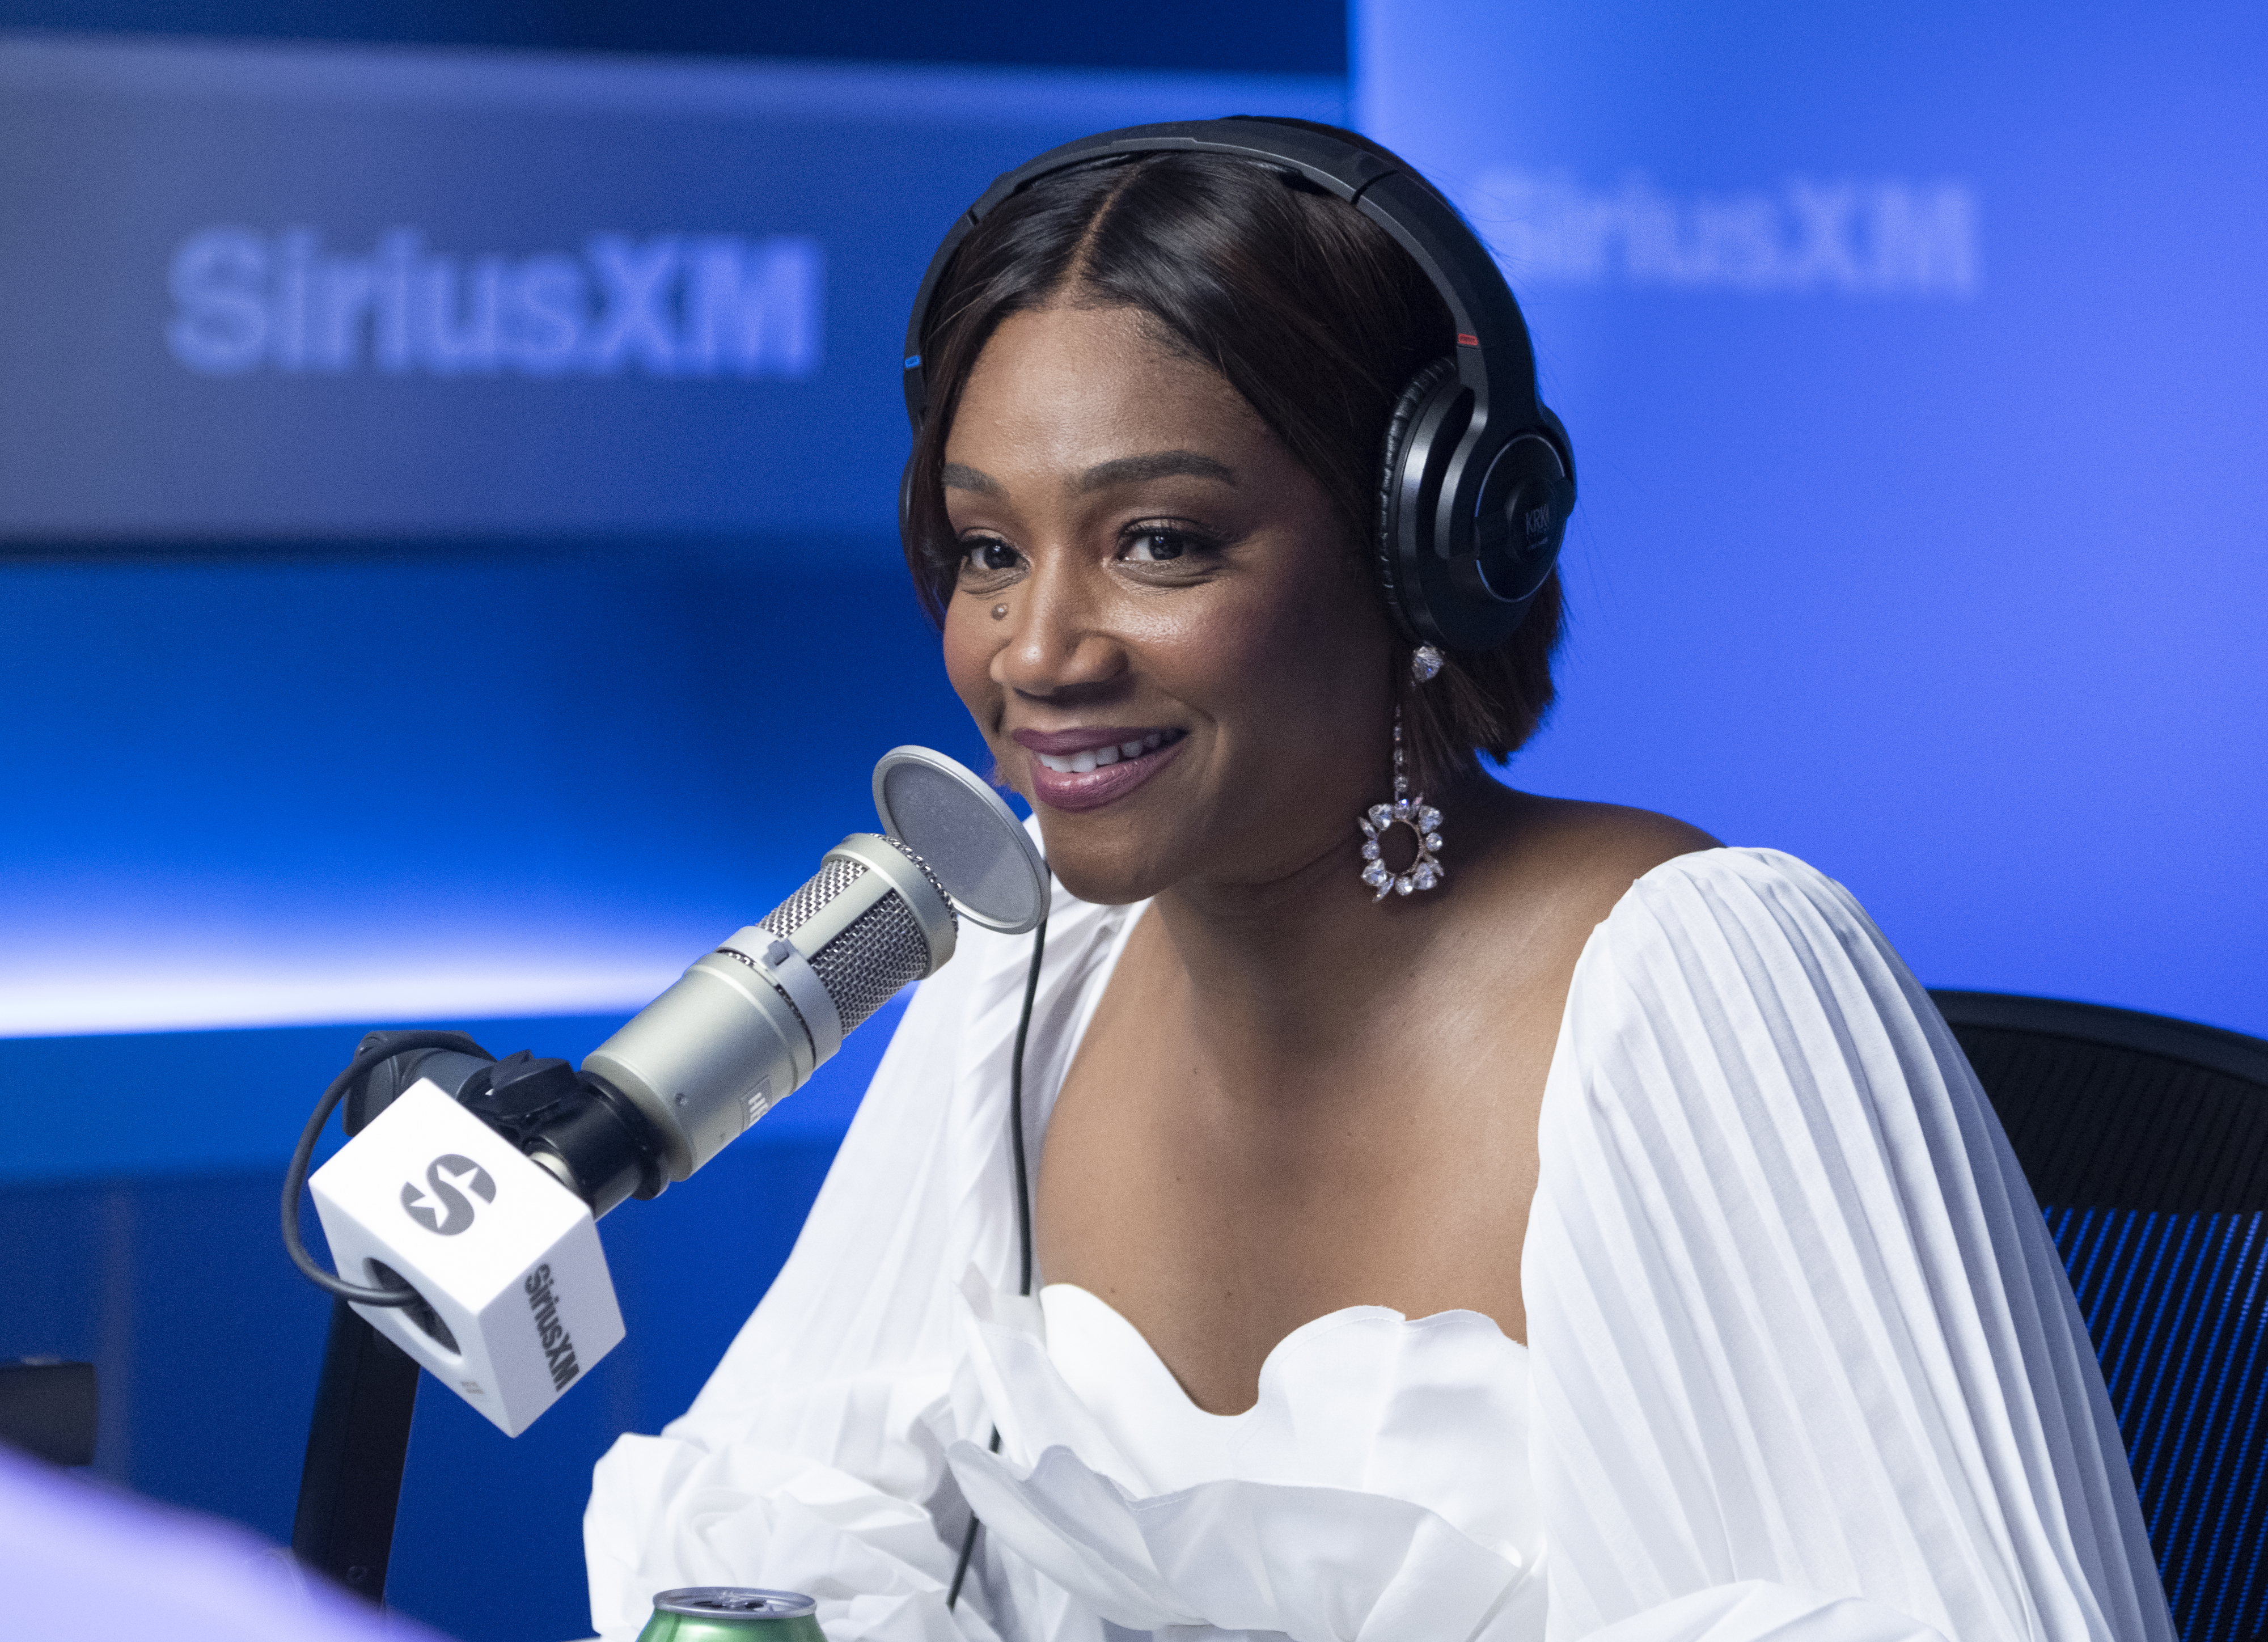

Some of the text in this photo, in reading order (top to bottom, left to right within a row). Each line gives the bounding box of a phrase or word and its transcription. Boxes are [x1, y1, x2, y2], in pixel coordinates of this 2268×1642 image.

[1470, 168, 1979, 299] SiriusXM
[168, 227, 822, 376] SiriusXM
[524, 1264, 579, 1392] SiriusXM
